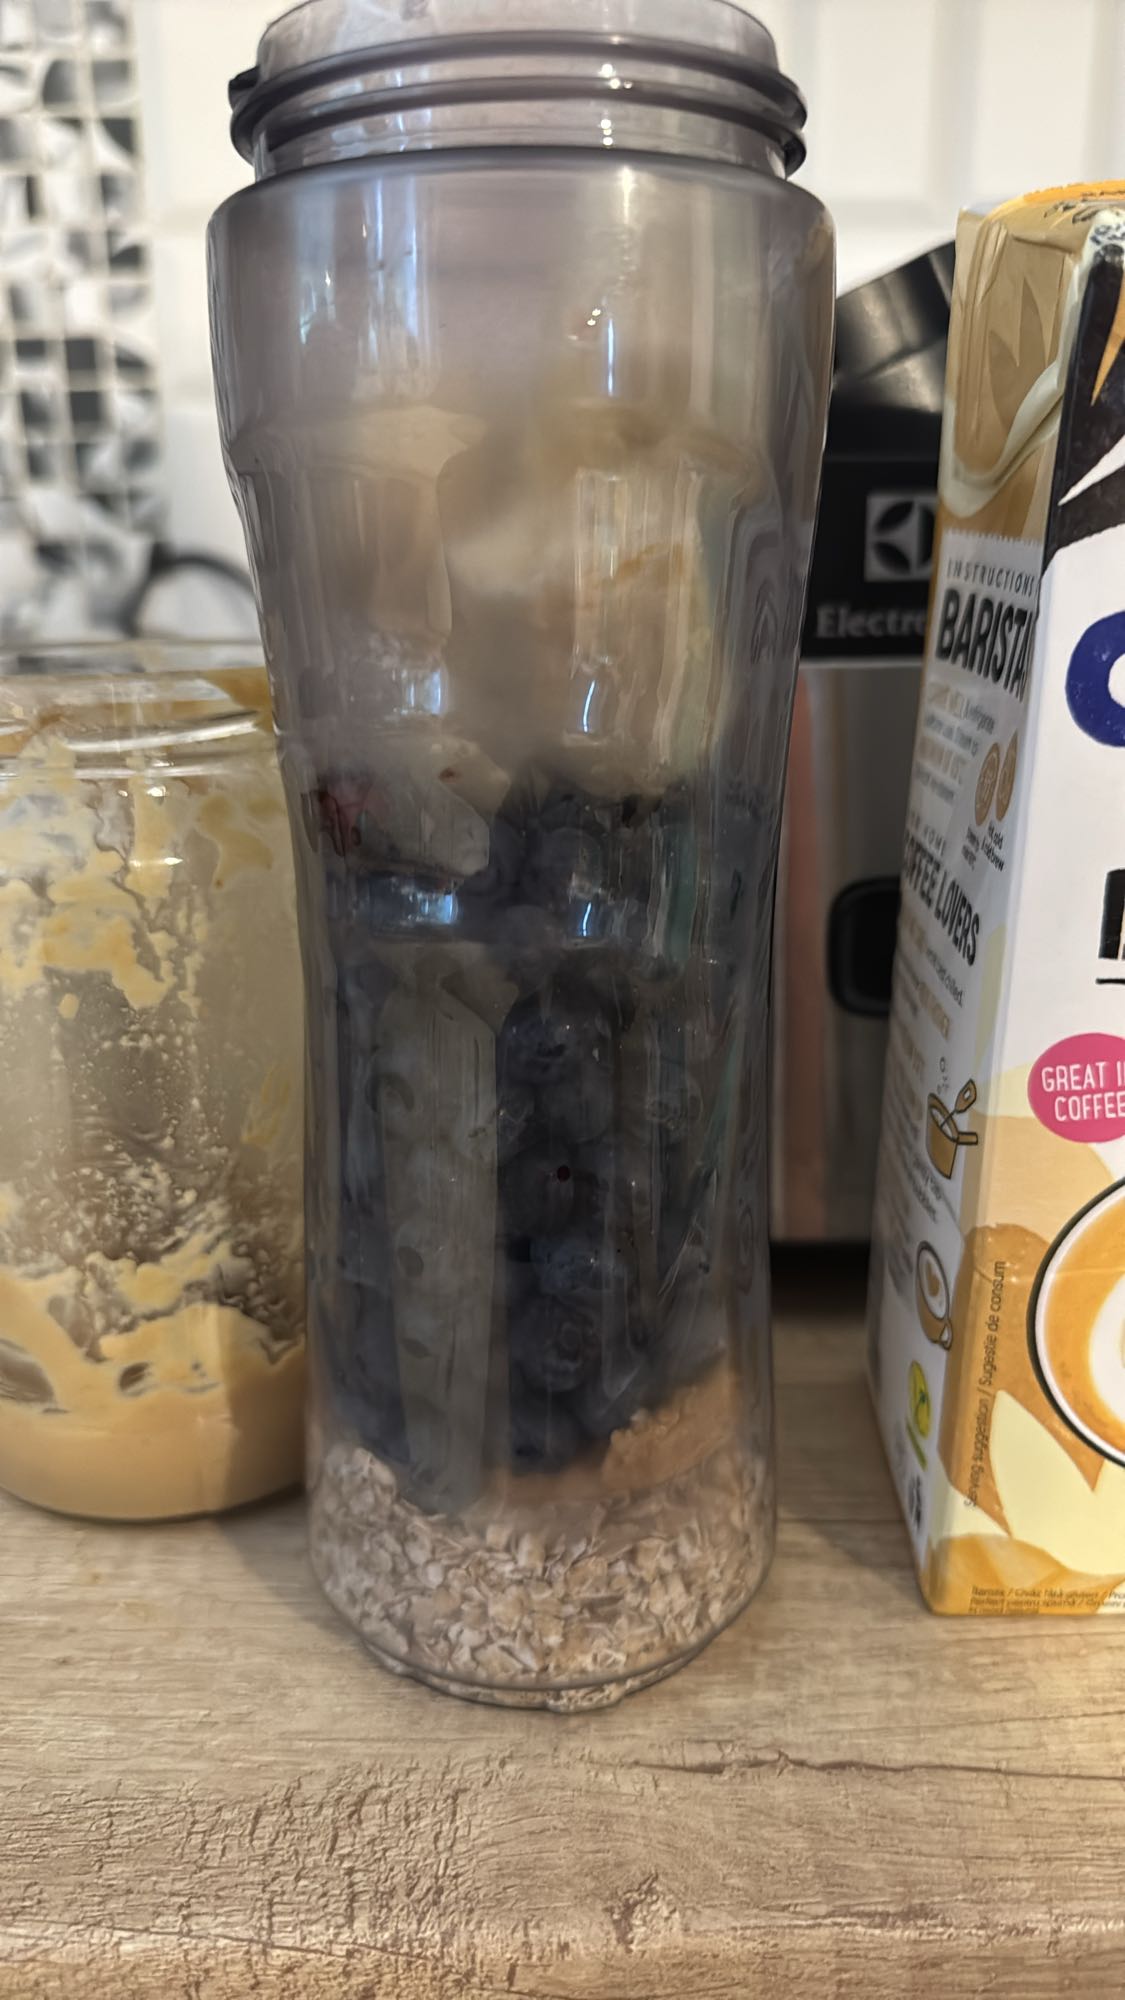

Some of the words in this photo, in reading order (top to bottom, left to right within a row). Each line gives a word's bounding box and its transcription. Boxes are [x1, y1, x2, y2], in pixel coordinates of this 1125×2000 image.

[934, 869, 979, 966] LOVERS
[1041, 1061, 1107, 1092] GREAT
[1054, 1090, 1125, 1121] COFFEE
[990, 1261, 1006, 1313] consum
[985, 1314, 1000, 1332] de
[979, 1334, 997, 1386] Sugestie
[972, 1398, 990, 1461] suggestion
[964, 1463, 985, 1507] Serving
